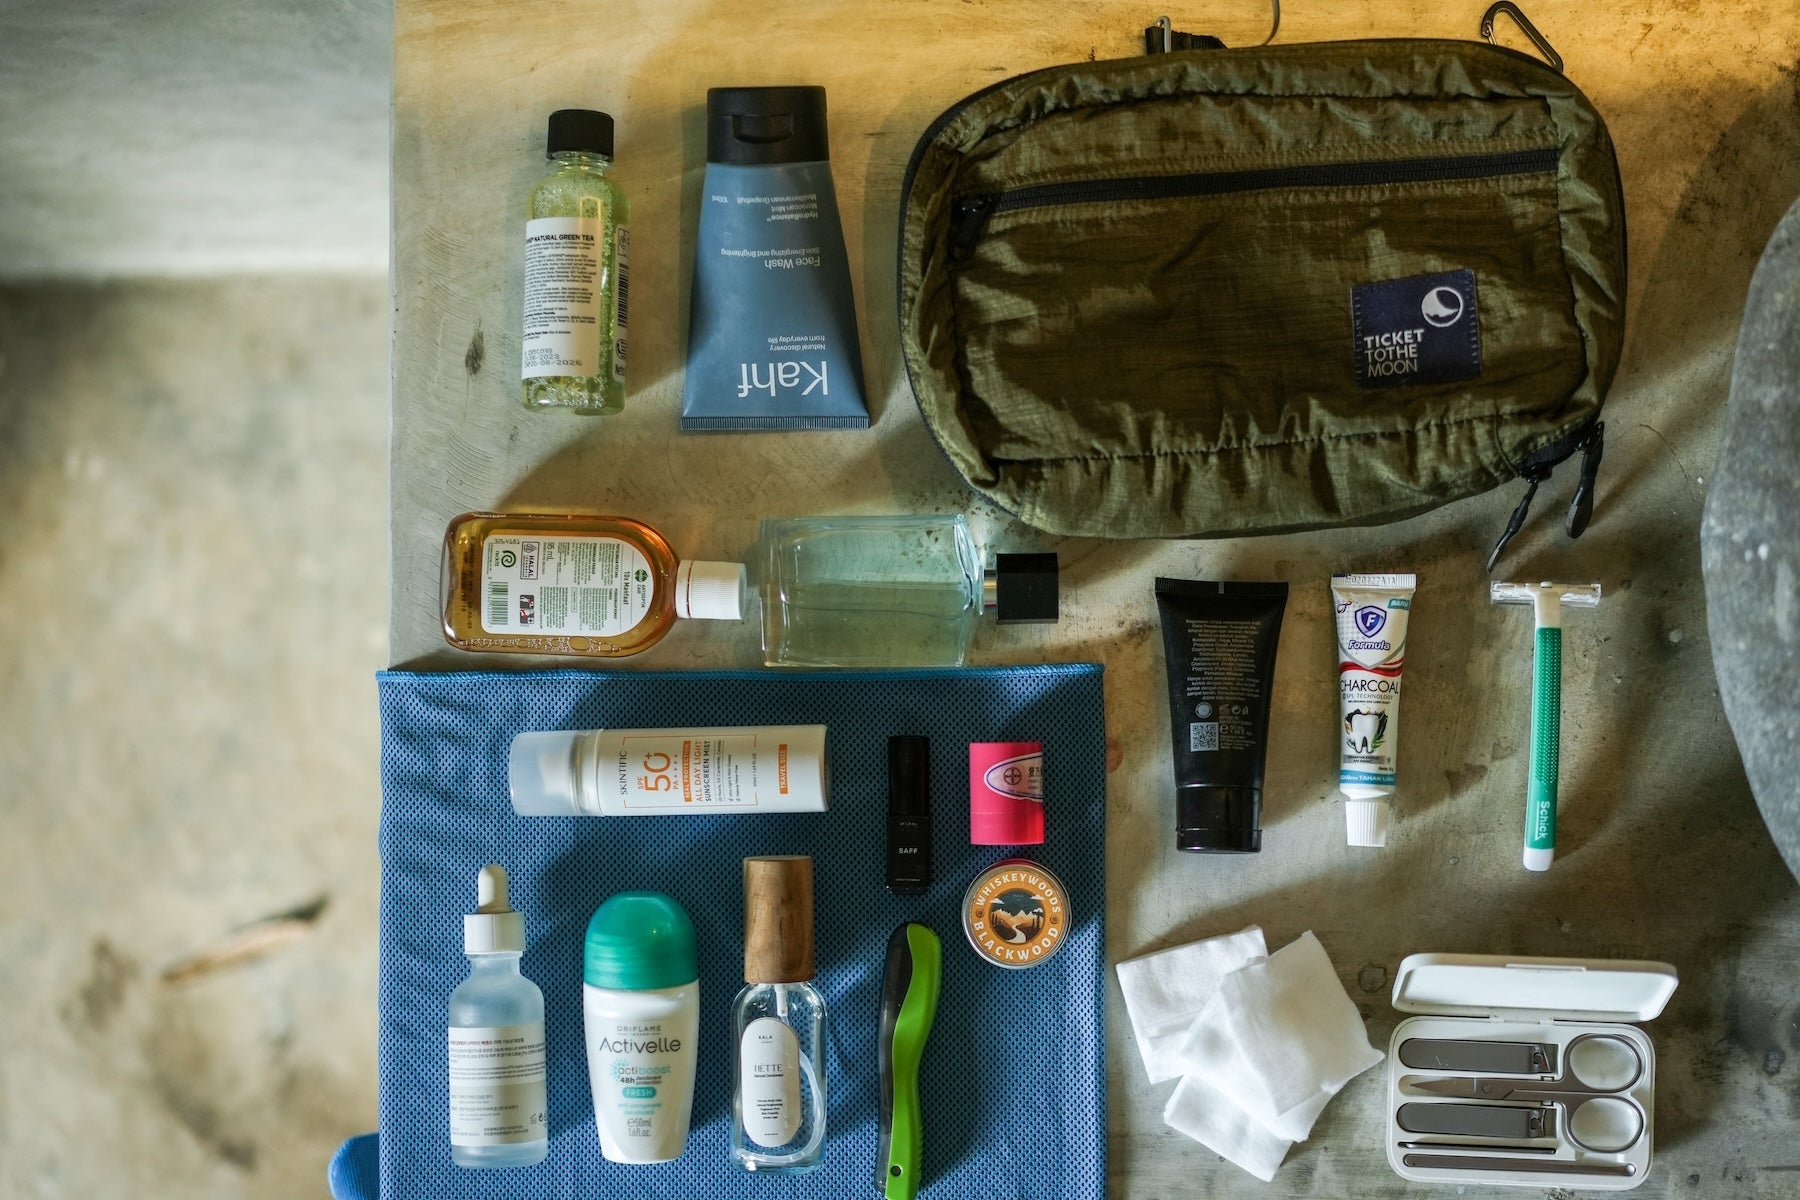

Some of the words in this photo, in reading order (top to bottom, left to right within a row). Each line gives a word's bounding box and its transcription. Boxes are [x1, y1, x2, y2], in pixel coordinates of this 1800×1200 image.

[736, 197, 770, 205] Grapefruit
[534, 234, 558, 242] NATURAL
[721, 248, 757, 258] Brightening
[770, 248, 805, 257] Energizing
[764, 259, 794, 269] Wash
[795, 256, 820, 267] Face
[778, 336, 808, 344] everyday
[1363, 328, 1425, 349] TICKET
[1368, 359, 1418, 377] MOON
[737, 361, 829, 397] Kahf
[1348, 640, 1391, 651] Formula
[1340, 679, 1399, 694] CHARCOAL
[694, 741, 703, 765] LIGHT
[703, 740, 711, 757] MIST
[619, 750, 628, 795] SKINTIFIC
[693, 768, 702, 786] DAY
[703, 758, 712, 802] SUNSCREEN
[780, 766, 788, 791] TRAVEL
[695, 788, 704, 802] ALL
[1538, 800, 1550, 839] Schick
[898, 847, 919, 855] SAFF
[976, 873, 1061, 913] WHISKEYWOODS
[973, 921, 1059, 961] BLACKWOOD
[599, 1037, 682, 1054] Activelle
[617, 1065, 671, 1075] actiboost
[626, 1088, 653, 1097] FRESH
